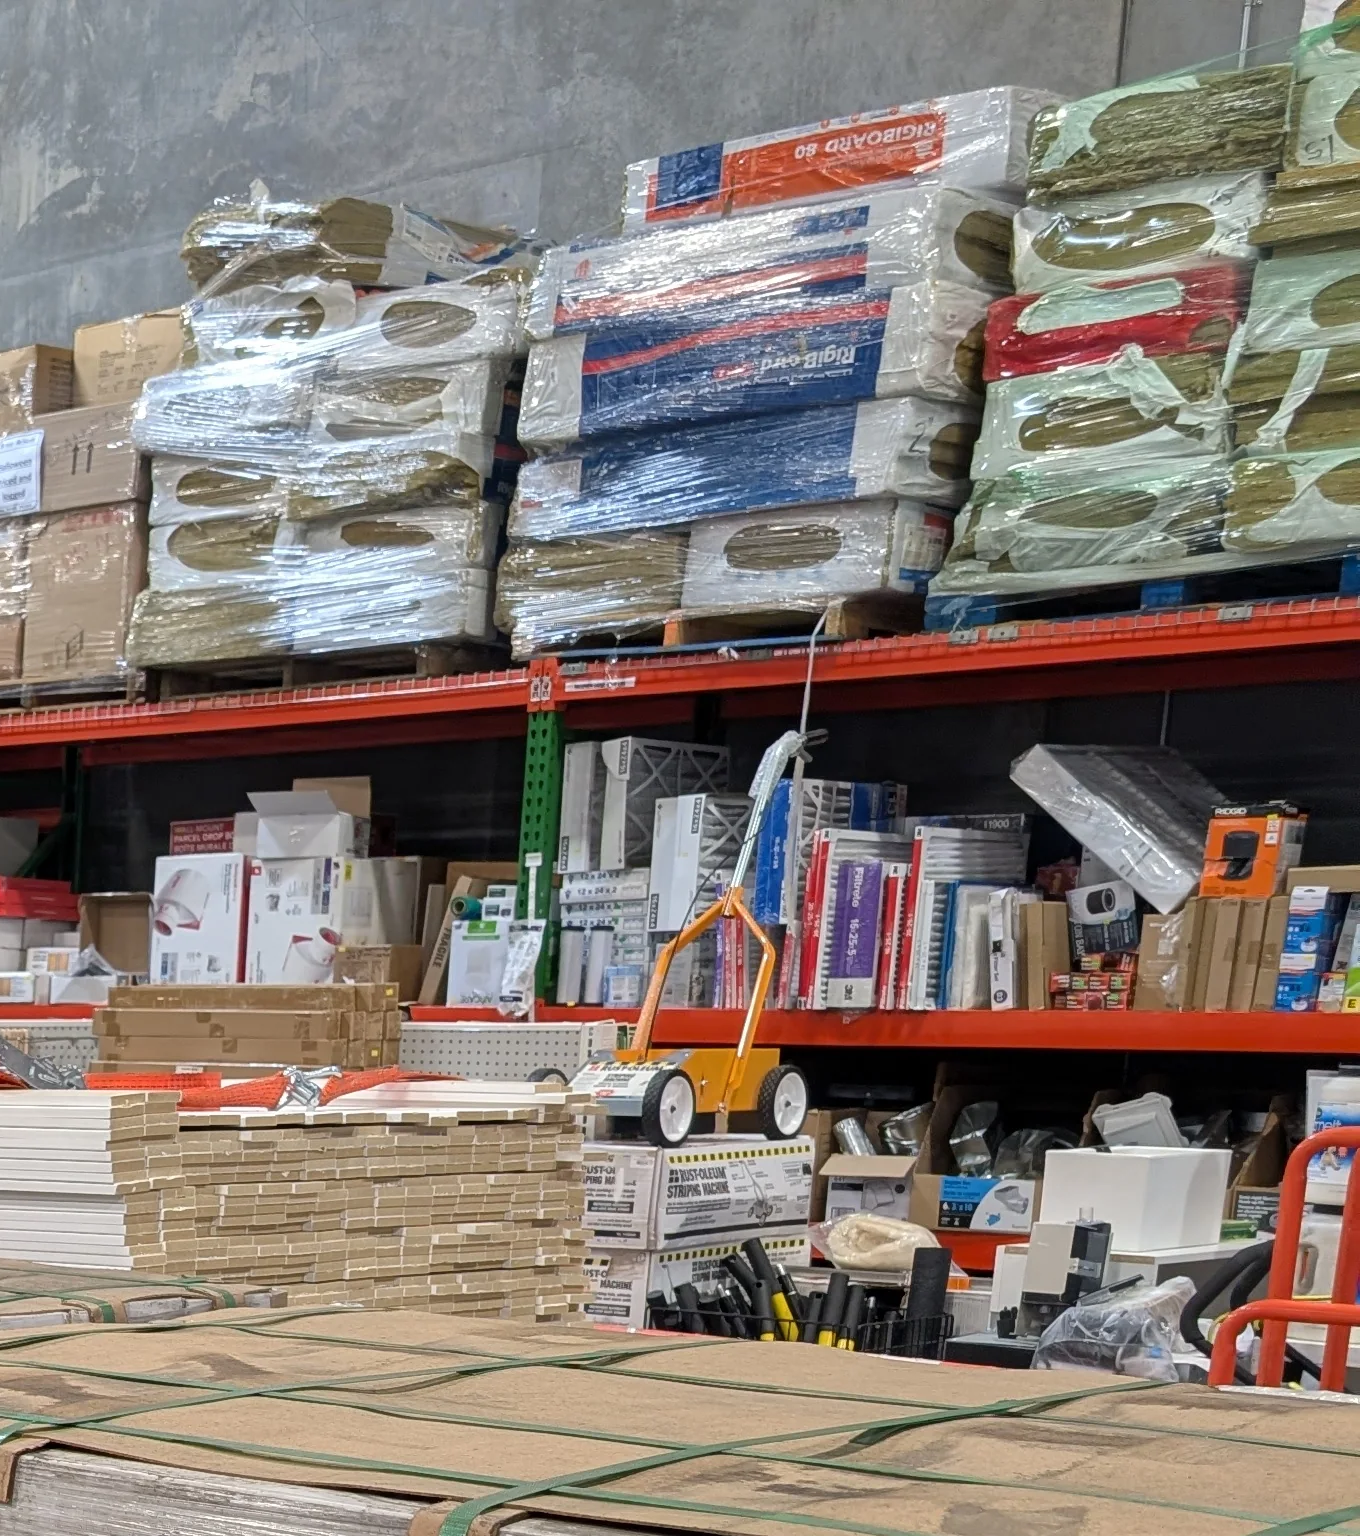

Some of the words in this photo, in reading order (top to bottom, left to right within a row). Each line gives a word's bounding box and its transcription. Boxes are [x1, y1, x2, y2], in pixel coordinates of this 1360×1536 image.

[825, 122, 936, 152] RIGIBOARD
[794, 143, 817, 159] 80
[1214, 807, 1248, 816] RIDGID
[851, 867, 864, 908] Filtrete
[433, 928, 452, 968] FRAGILE
[844, 984, 855, 1001] 3M
[680, 1166, 727, 1182] RUST-OLEUM
[667, 1183, 701, 1199] STRIPING
[703, 1181, 730, 1196] MACHINE
